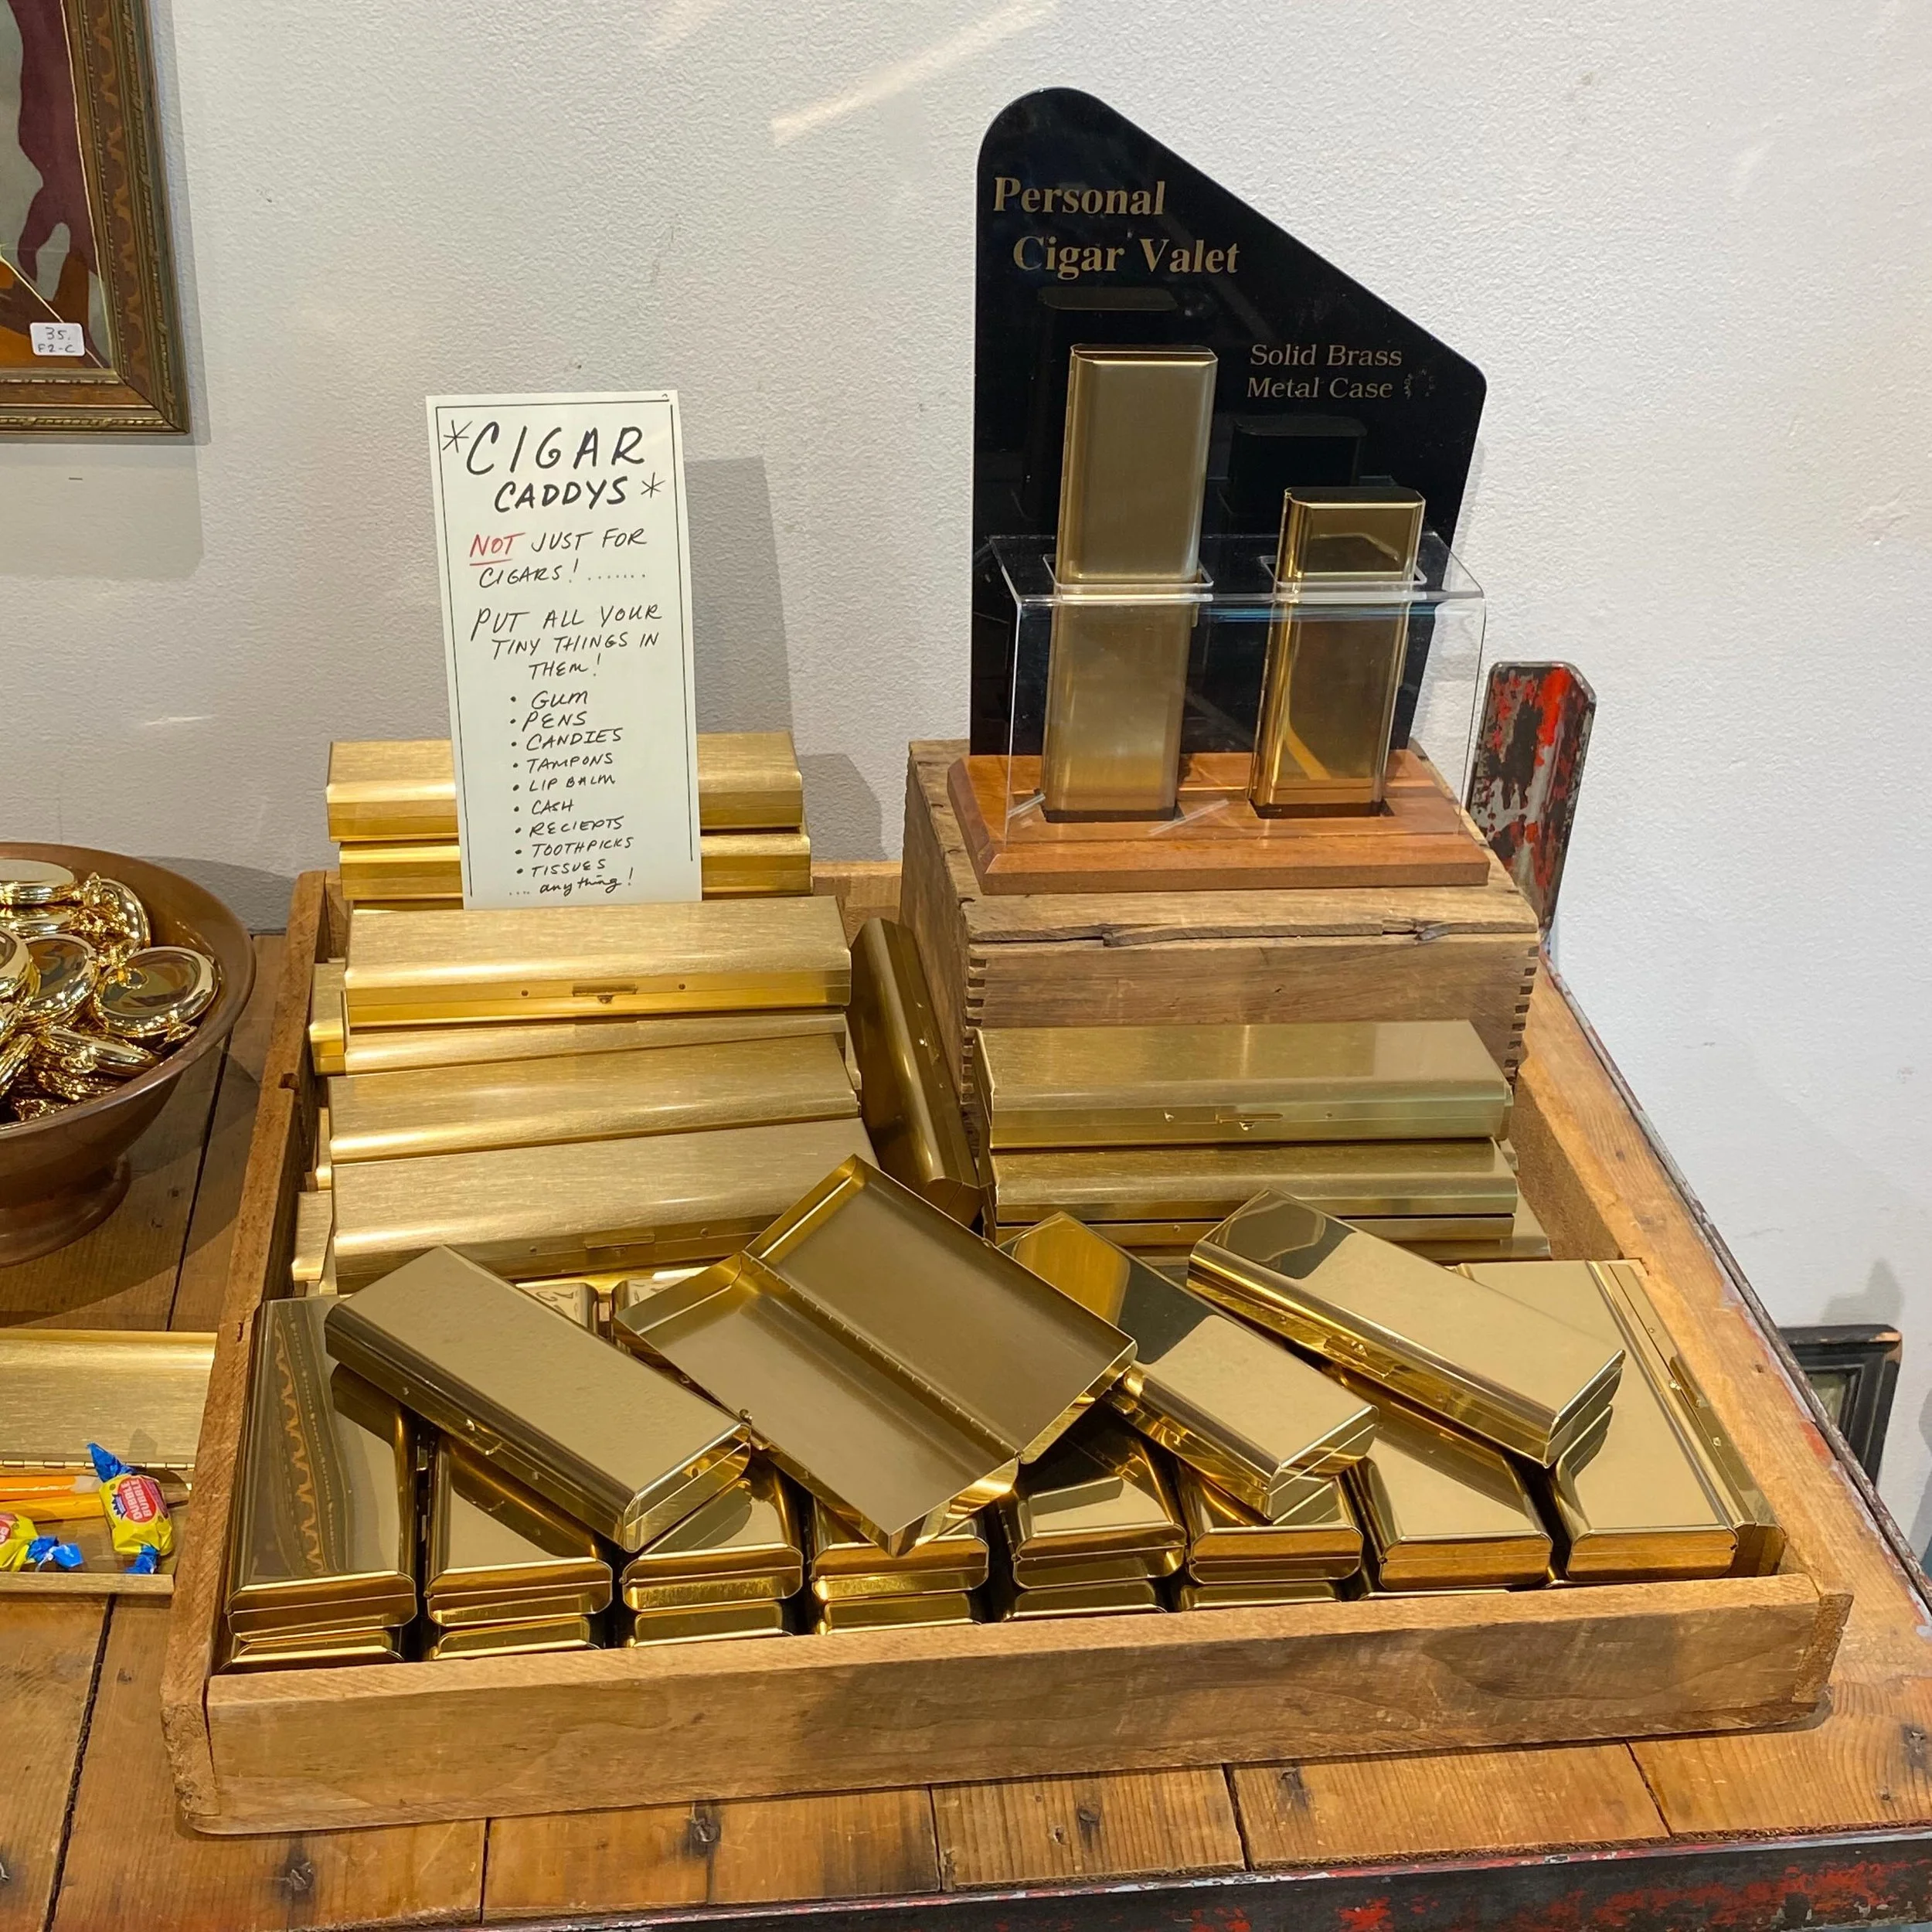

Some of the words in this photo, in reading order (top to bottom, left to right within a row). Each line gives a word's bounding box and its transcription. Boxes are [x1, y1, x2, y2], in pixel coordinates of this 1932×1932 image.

[993, 177, 1165, 216] Personal
[1013, 236, 1125, 281] Cigar
[1138, 238, 1240, 273] Valet
[1250, 344, 1316, 366] Solid
[1326, 345, 1402, 366] Brass
[1247, 377, 1320, 398] Metal
[1329, 378, 1393, 399] Case
[469, 532, 526, 557] NOT
[531, 532, 594, 552] JUST
[602, 528, 647, 548] FOR
[471, 608, 529, 641] PUT
[543, 609, 584, 629] ALL
[601, 604, 662, 628] YOUR
[492, 638, 540, 660] TINY
[554, 631, 628, 653] THINGS
[640, 632, 658, 648] IN
[529, 652, 601, 680] THEM!
[522, 711, 587, 732] PENS
[526, 727, 623, 751] CANDIES
[527, 753, 613, 774] TAMPONS
[529, 778, 557, 791] LIP
[566, 774, 615, 787] BALM
[532, 799, 573, 815] CASH
[529, 815, 624, 838] RECIEPTS
[532, 837, 634, 858] TOOTHPICKS
[532, 859, 606, 877] TISSUES
[121, 1480, 143, 1520] DUBBLE
[130, 1477, 153, 1517] BUBBLE
